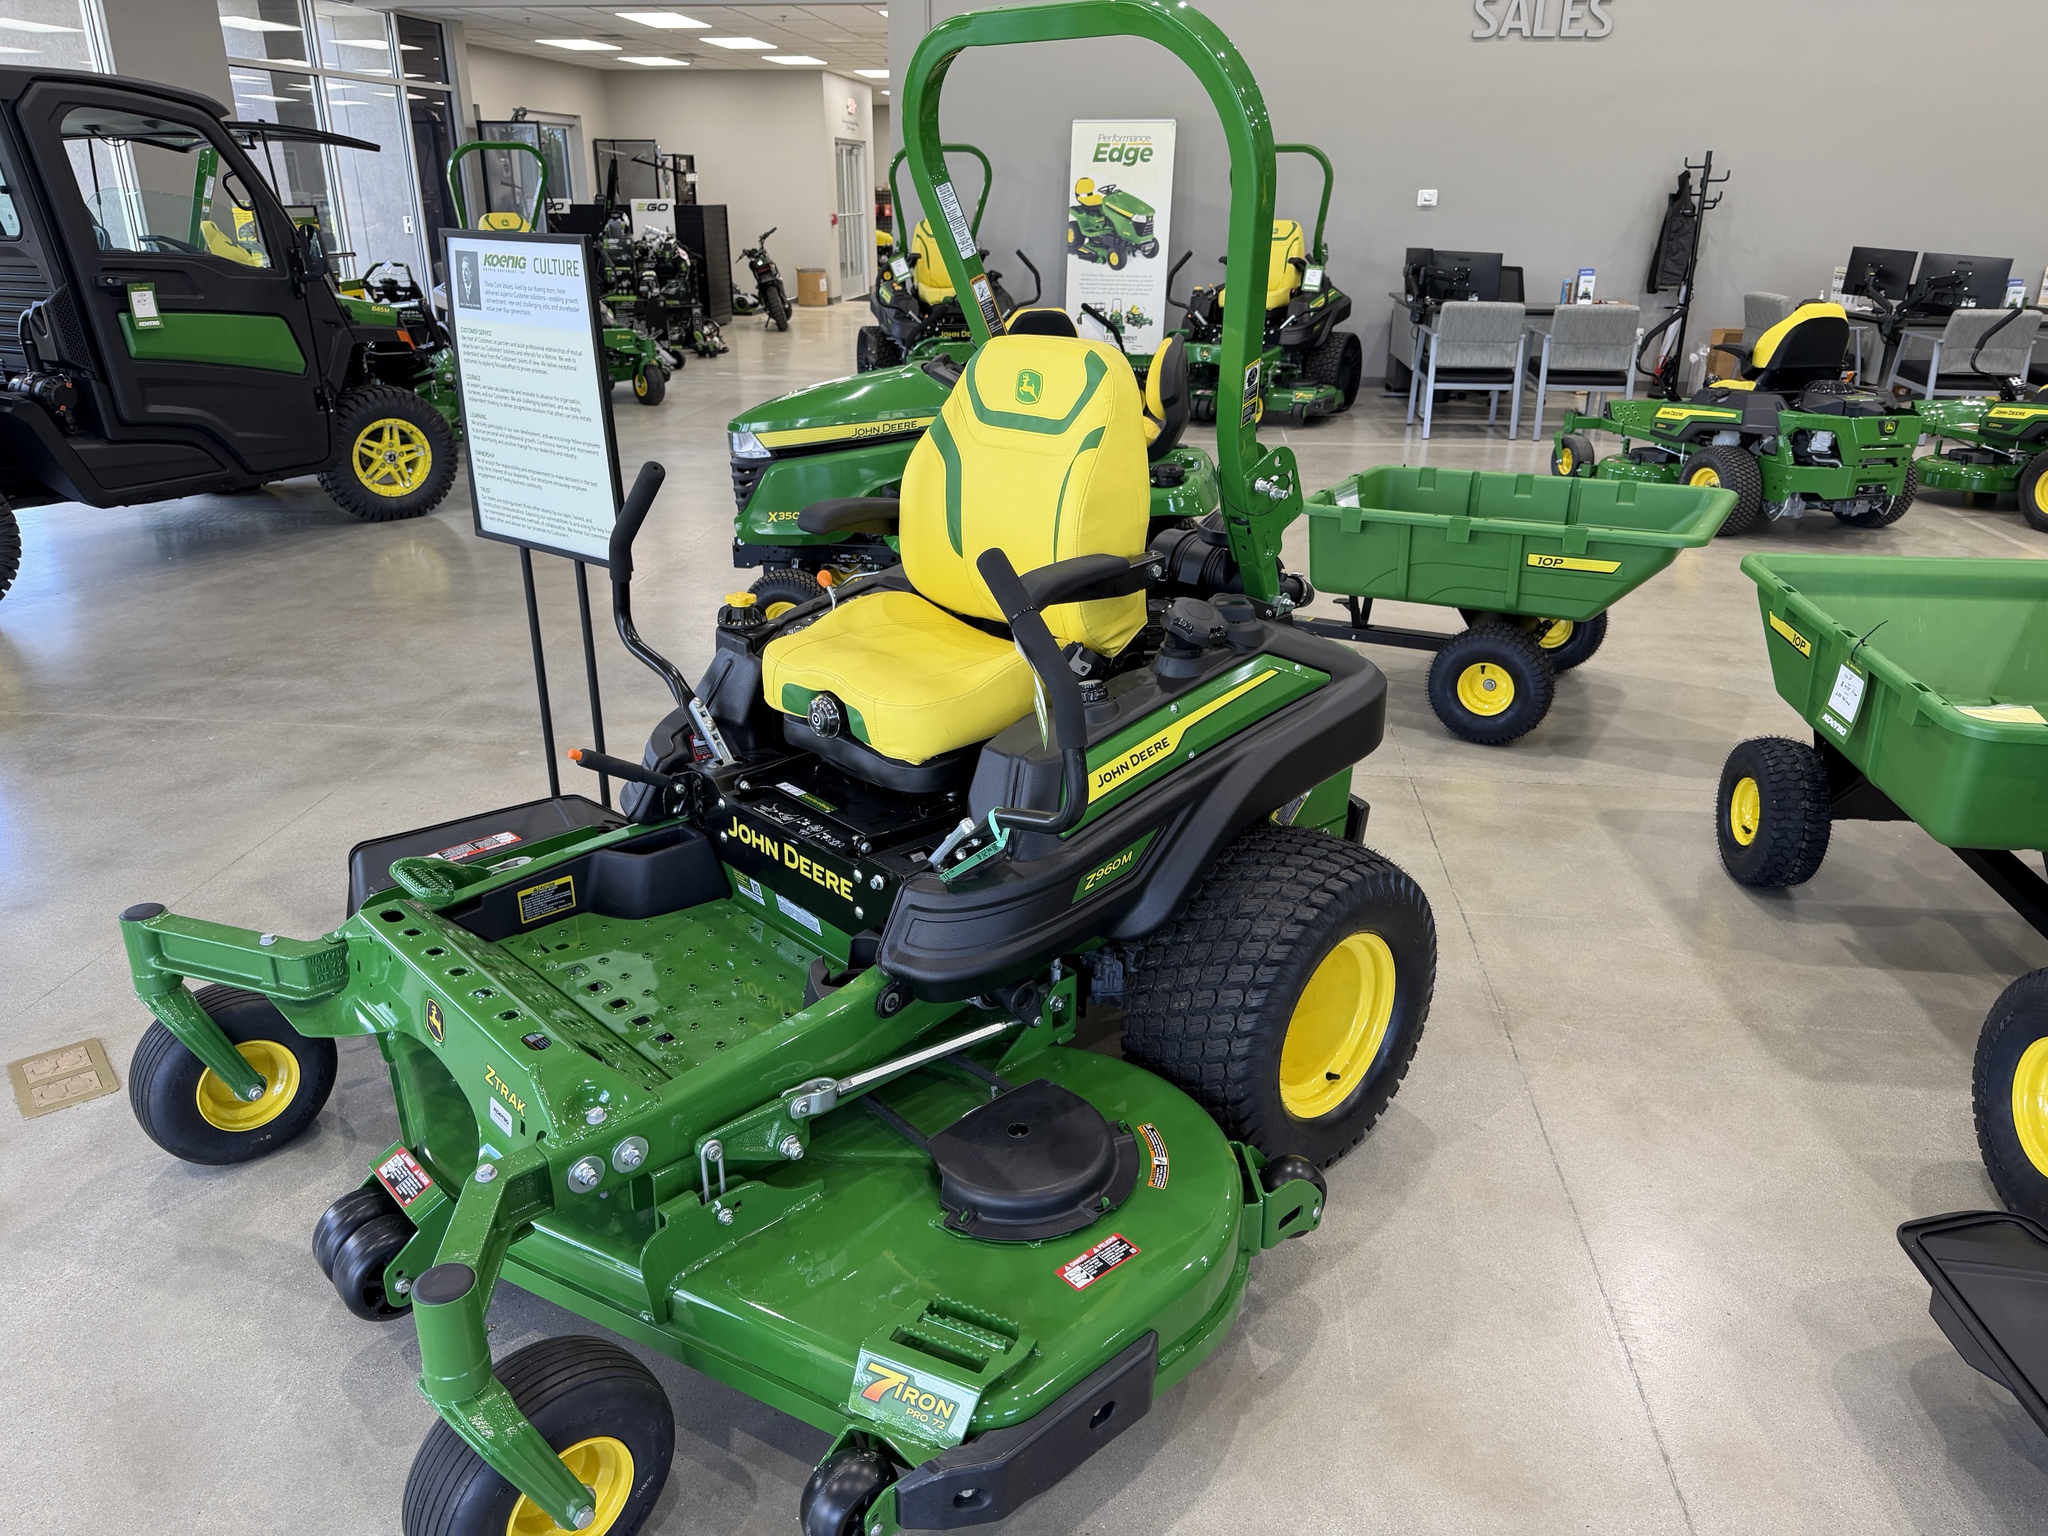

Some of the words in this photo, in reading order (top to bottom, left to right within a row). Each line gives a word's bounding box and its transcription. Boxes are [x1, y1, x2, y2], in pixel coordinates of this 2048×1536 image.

[1472, 0, 1613, 38] SALES
[1098, 133, 1151, 142] Performance
[1092, 142, 1153, 167] Edge
[636, 203, 668, 212] EGO
[533, 257, 580, 277] CULTURE
[851, 426, 882, 438] JOHN
[882, 420, 918, 434] DEERE
[1536, 556, 1564, 567] 10P
[1792, 633, 1806, 649] 10P
[1097, 761, 1130, 788] JOHN
[1130, 737, 1170, 769] DEERE
[728, 815, 780, 861] JOHN
[784, 842, 854, 903] DEERE
[1084, 850, 1134, 892] Z960M
[484, 1063, 527, 1119] ZTRAK
[1069, 1254, 1090, 1268] DANGER
[1096, 1236, 1117, 1250] PELIGRO
[861, 1361, 910, 1403] 7
[892, 1382, 956, 1421] IRON
[905, 1408, 929, 1422] PRO
[932, 1418, 947, 1430] 72
